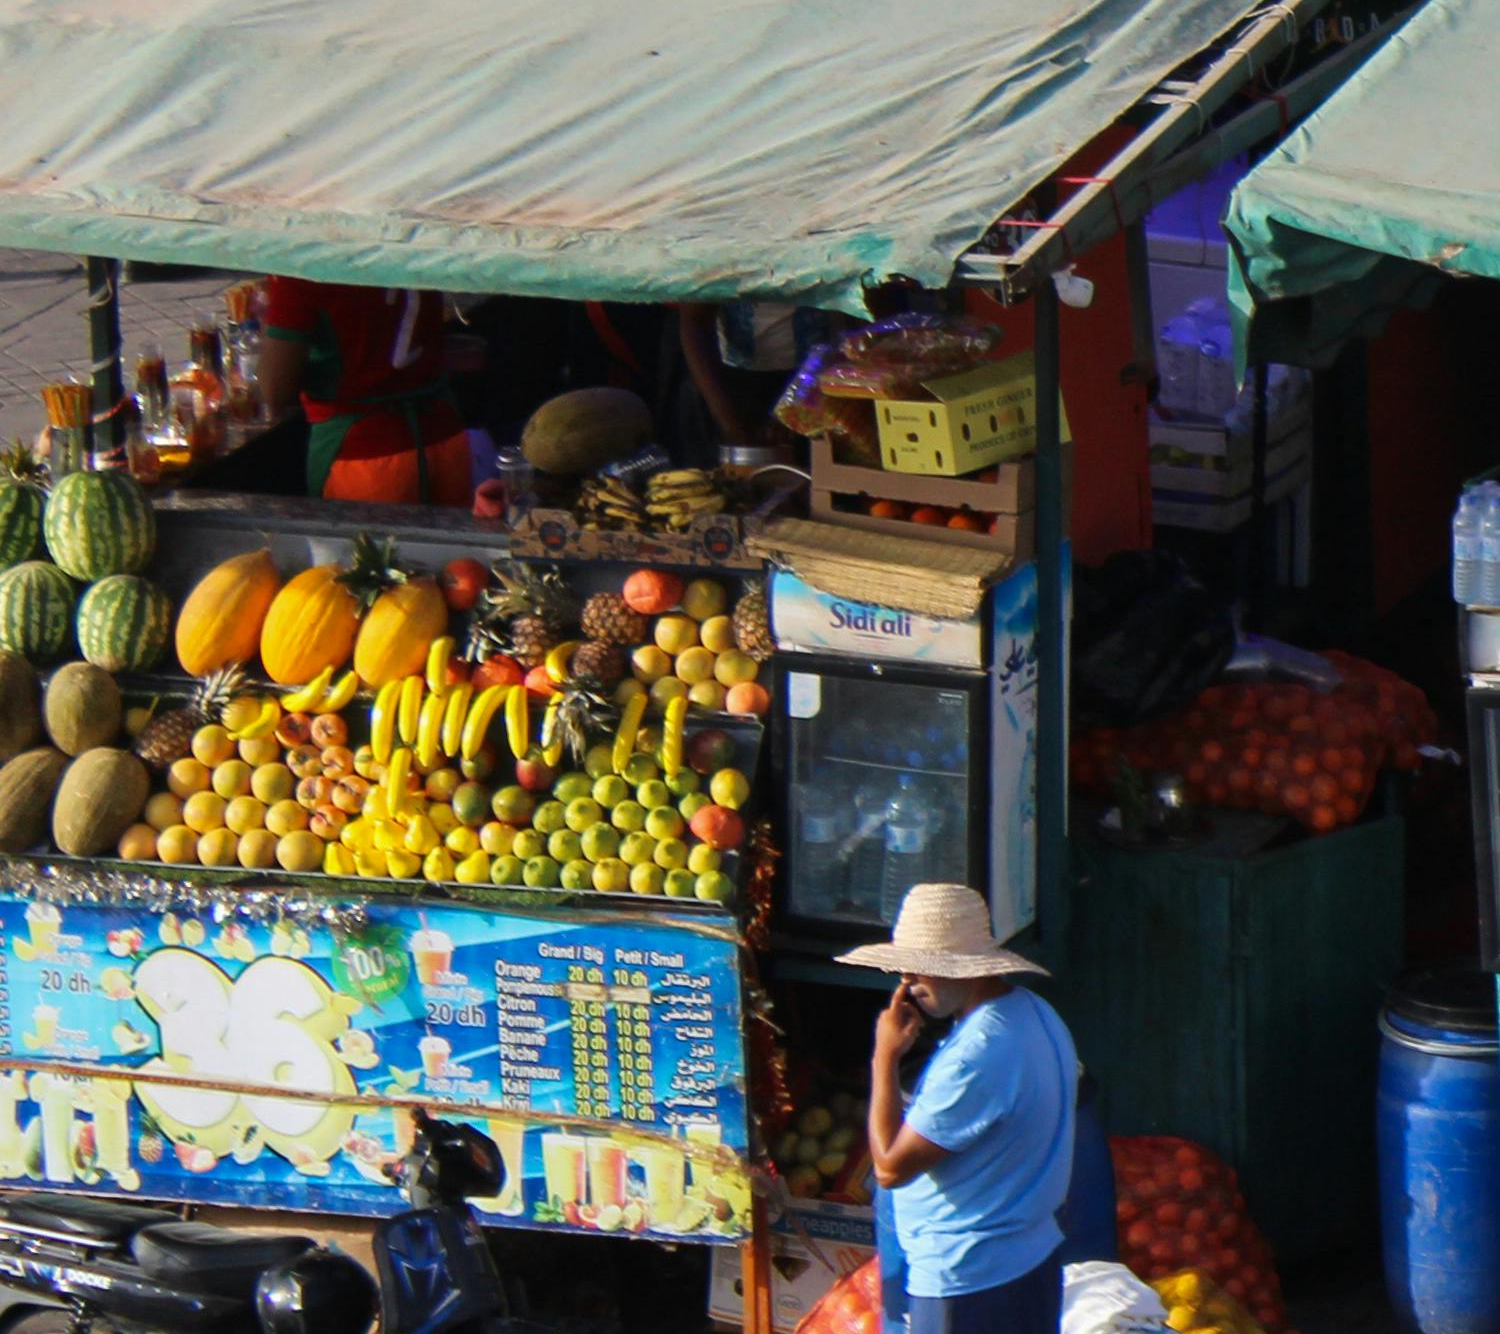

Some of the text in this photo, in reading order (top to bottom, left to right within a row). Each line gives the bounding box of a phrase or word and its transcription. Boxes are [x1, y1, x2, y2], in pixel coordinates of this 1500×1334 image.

[829, 603, 912, 637] Sidi ali
[539, 943, 574, 960] Grand
[583, 947, 604, 964] Big
[615, 948, 641, 965] Petit
[650, 952, 684, 968] Small
[40, 969, 92, 993] 20 dh
[495, 961, 648, 987] Orange 20 dh 10 dh
[425, 1002, 486, 1027] 20 dh
[497, 995, 650, 1020] Citron 20 dh 10 dh
[498, 1011, 650, 1037] Pomme 20 dh 10 dh
[499, 1028, 651, 1054] Banane 20 dh 10 dh
[574, 1051, 589, 1066] 20
[592, 1051, 608, 1067] dh
[619, 1055, 633, 1069] 10
[636, 1056, 652, 1070] dh
[501, 1062, 653, 1087] Pruneaux 20 dh 10 dh
[502, 1079, 653, 1104] Kaki 20 dh 10 dh
[577, 1101, 592, 1116] 20
[594, 1103, 610, 1118] dh
[622, 1105, 635, 1120] 10
[638, 1107, 654, 1122] dh
